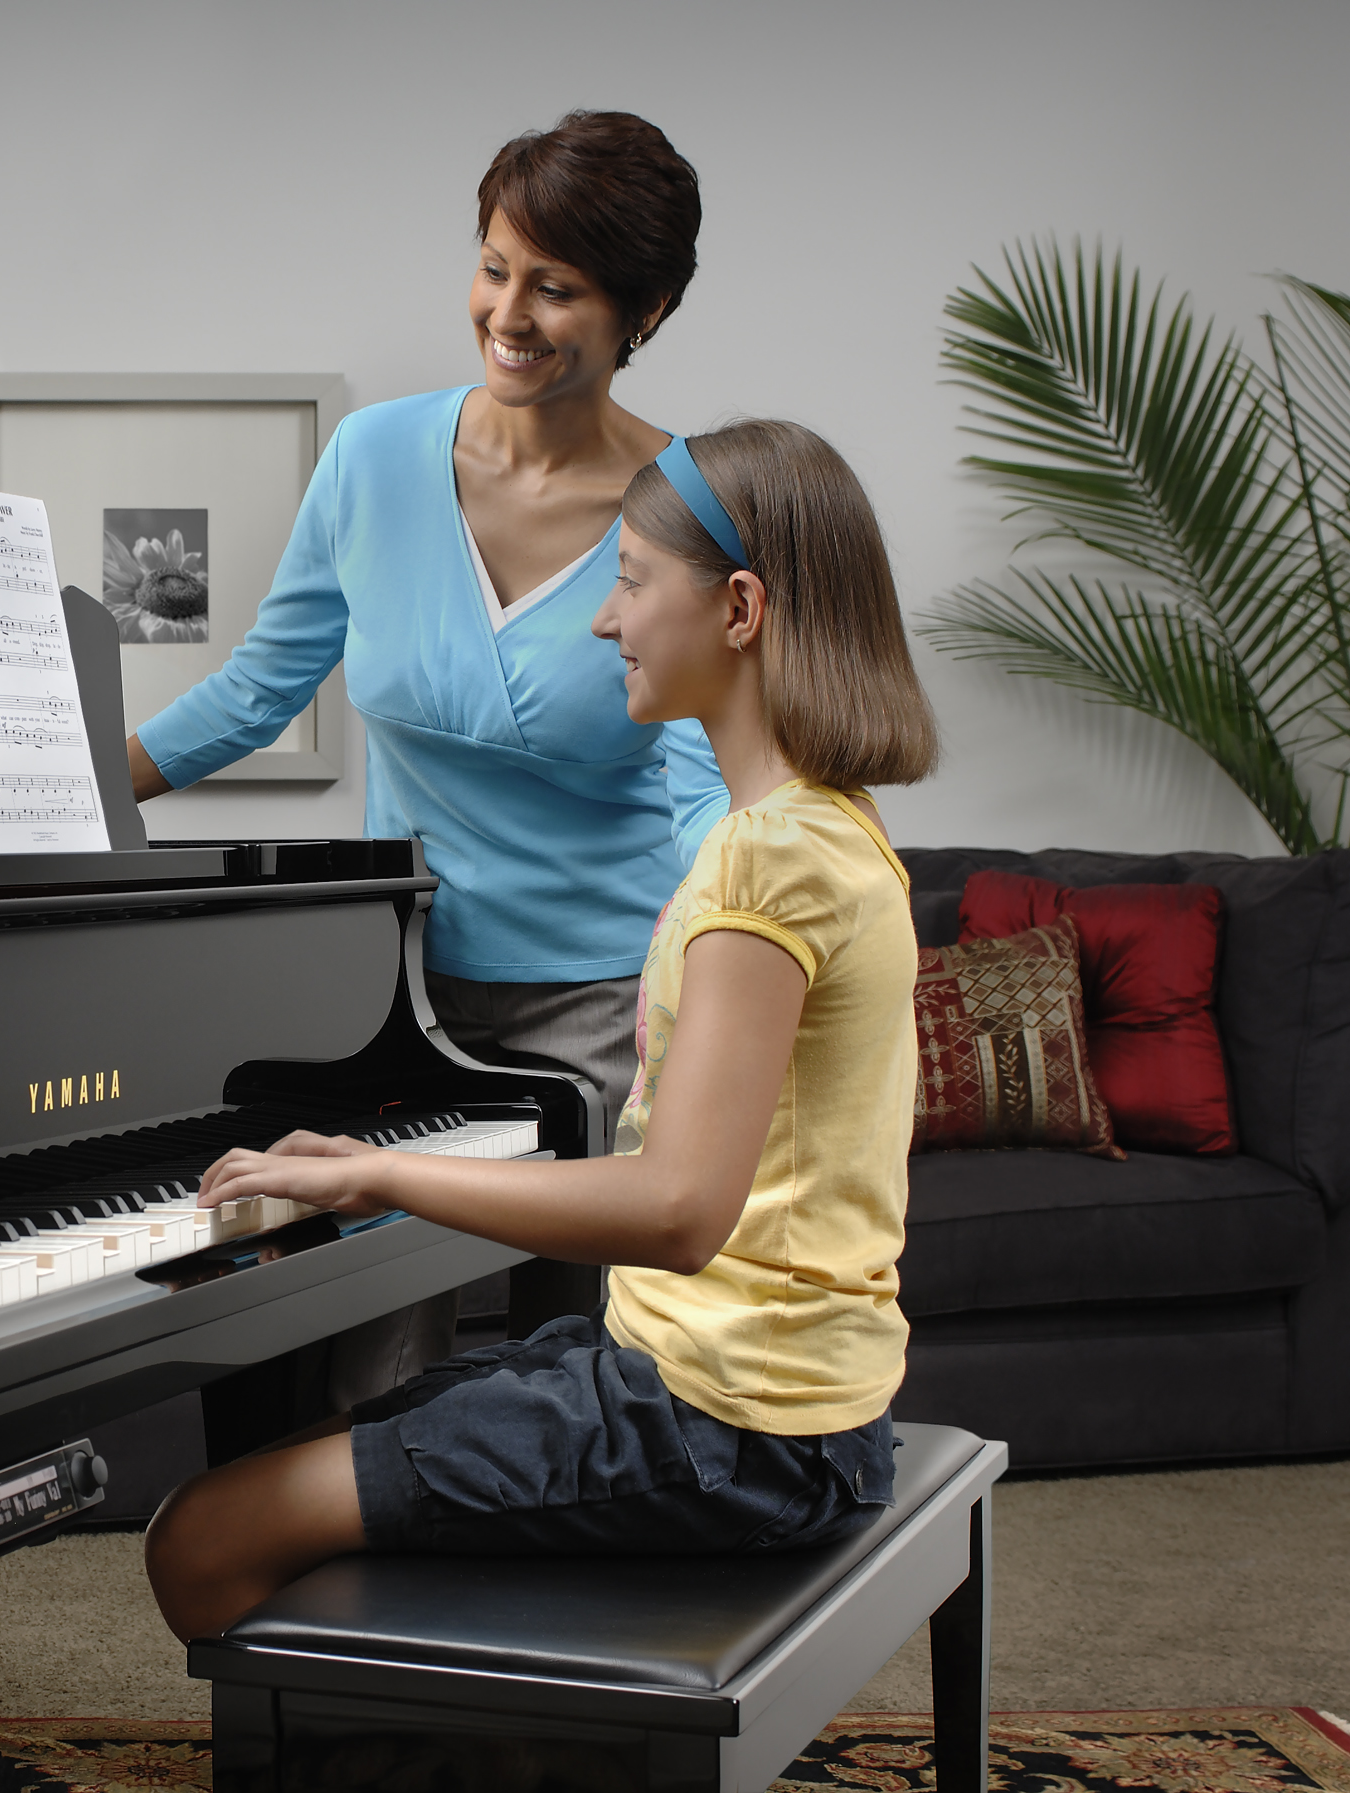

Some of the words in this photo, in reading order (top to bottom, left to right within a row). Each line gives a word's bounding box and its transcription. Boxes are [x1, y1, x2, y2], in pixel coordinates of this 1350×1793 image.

[29, 1069, 120, 1114] YAMAHA
[24, 1489, 47, 1512] Funny
[46, 1480, 62, 1501] Val
